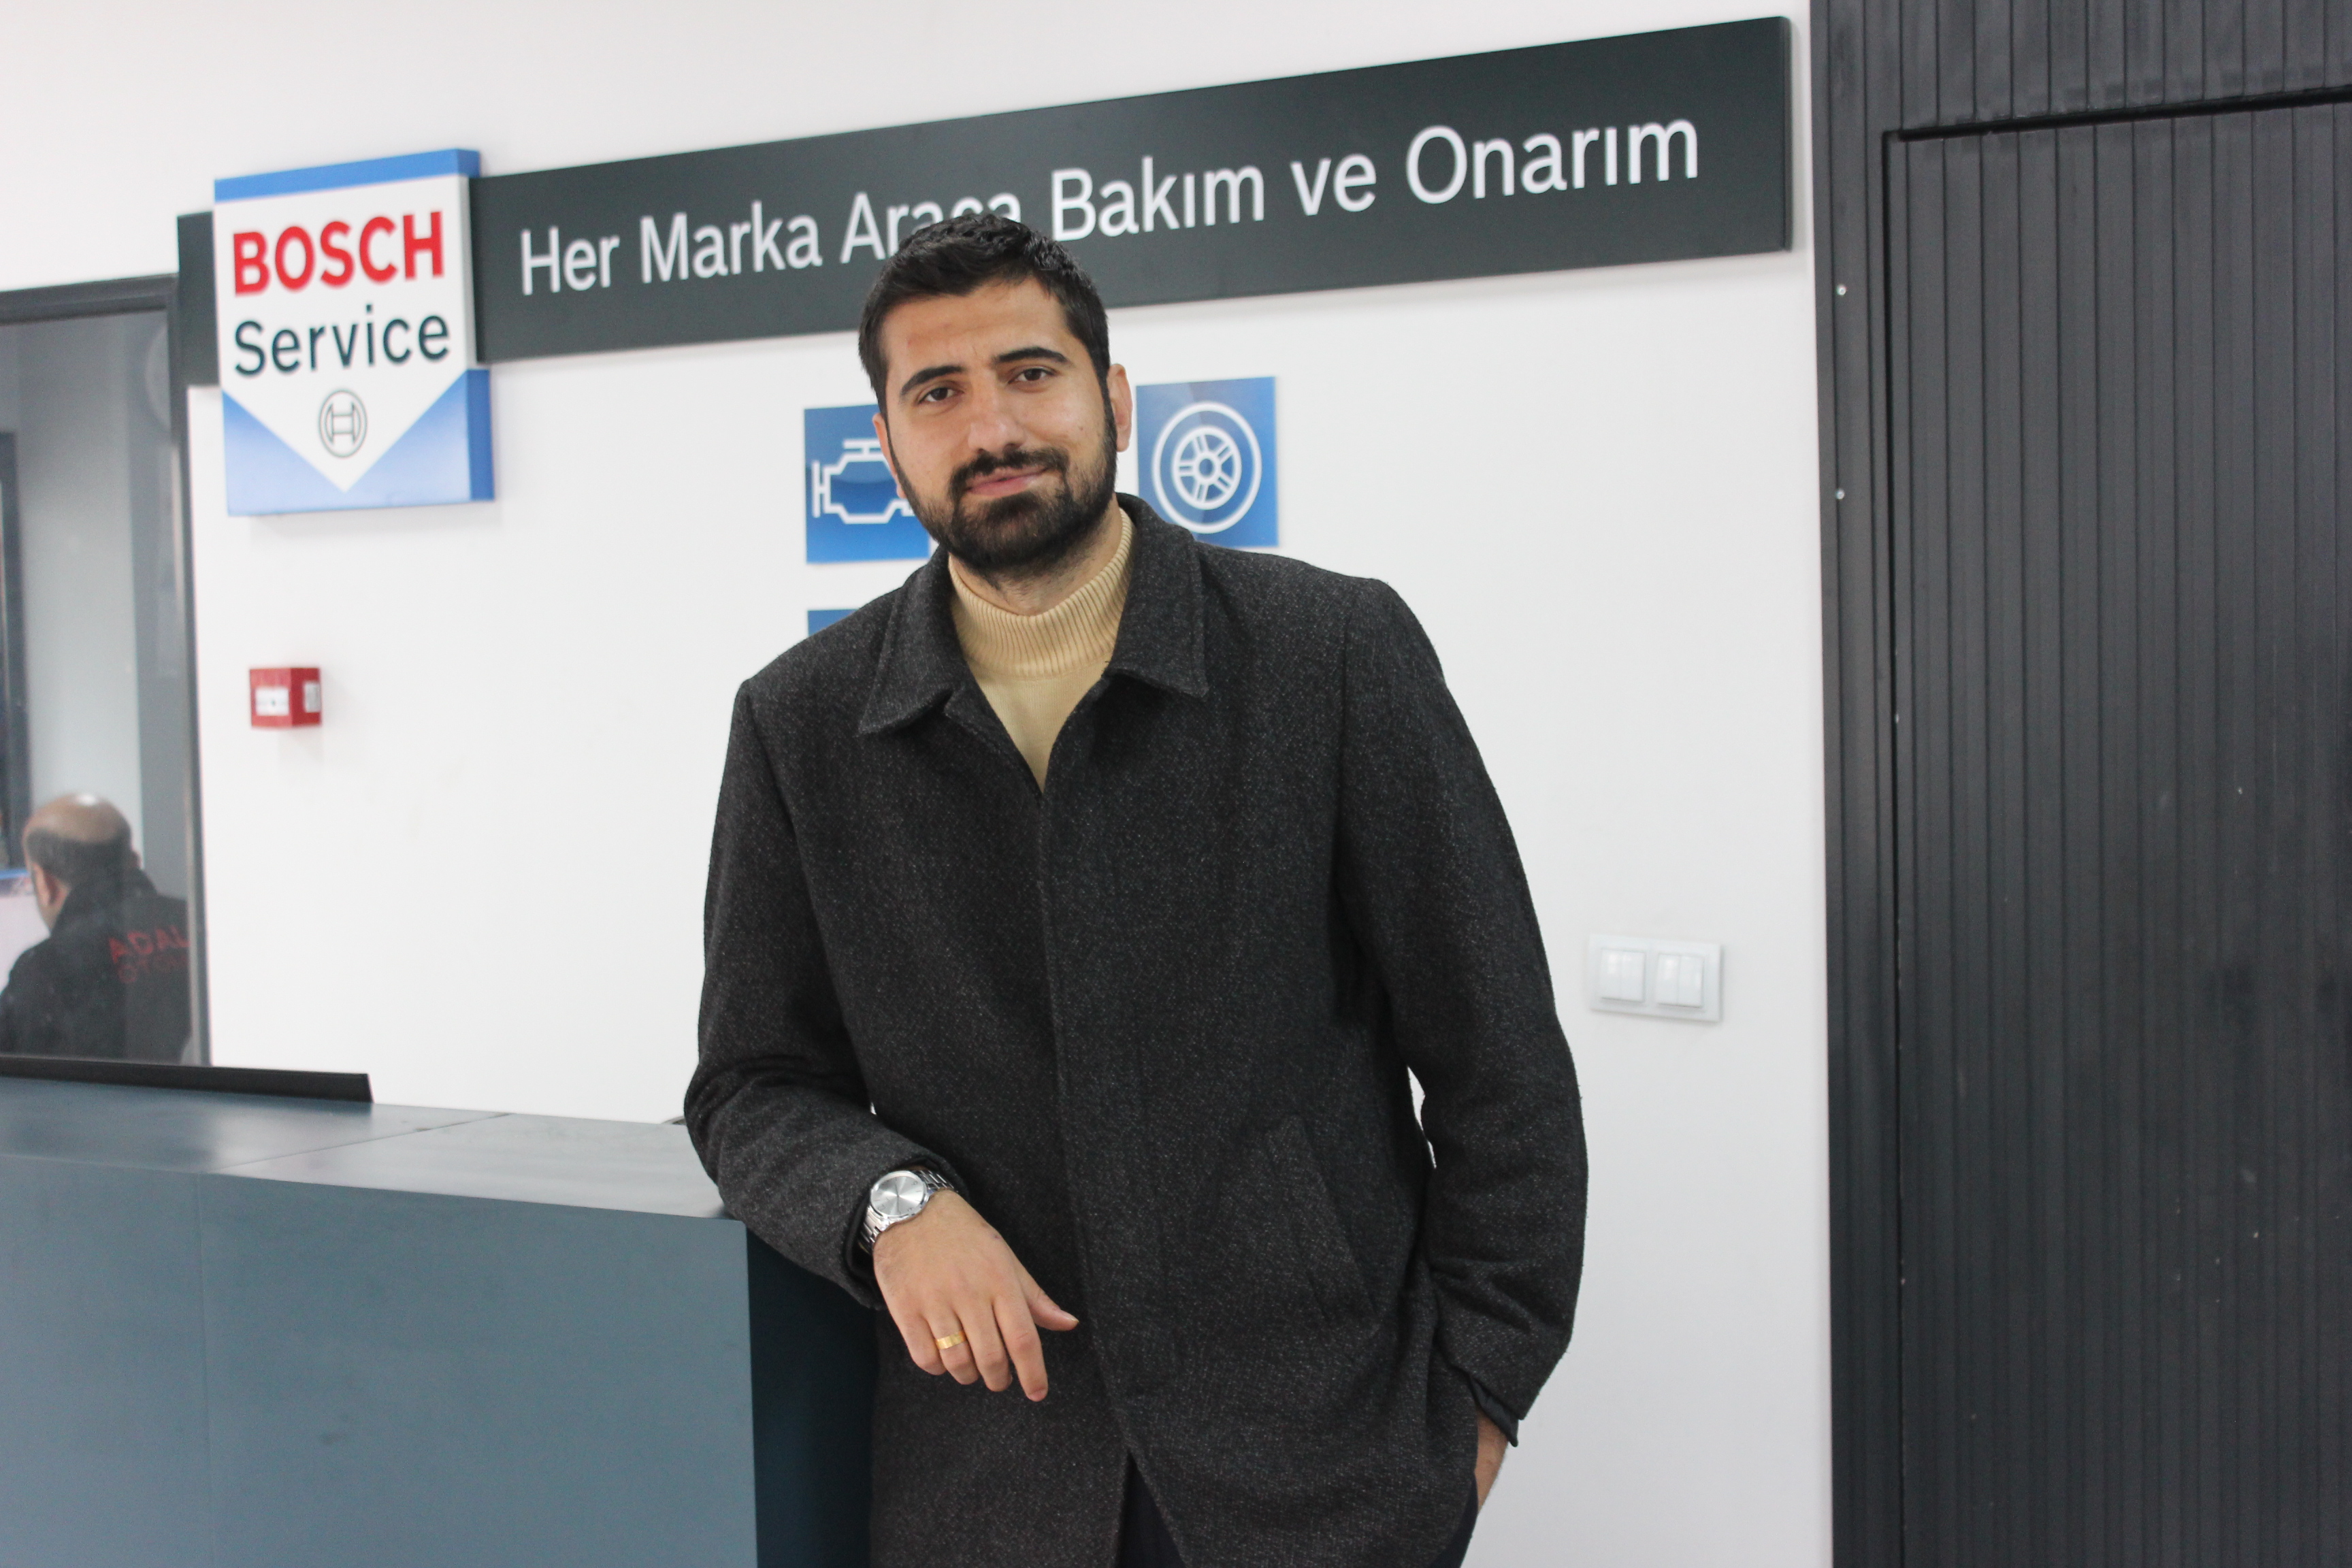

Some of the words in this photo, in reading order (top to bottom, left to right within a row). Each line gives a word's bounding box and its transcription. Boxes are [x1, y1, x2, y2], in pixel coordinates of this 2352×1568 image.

[520, 226, 621, 295] Her
[639, 199, 823, 284] Marka
[1050, 154, 1266, 243] Bakım
[1290, 153, 1377, 217] ve
[1405, 119, 1699, 205] Onarım
[233, 211, 444, 297] BOSCH
[234, 304, 449, 376] Service
